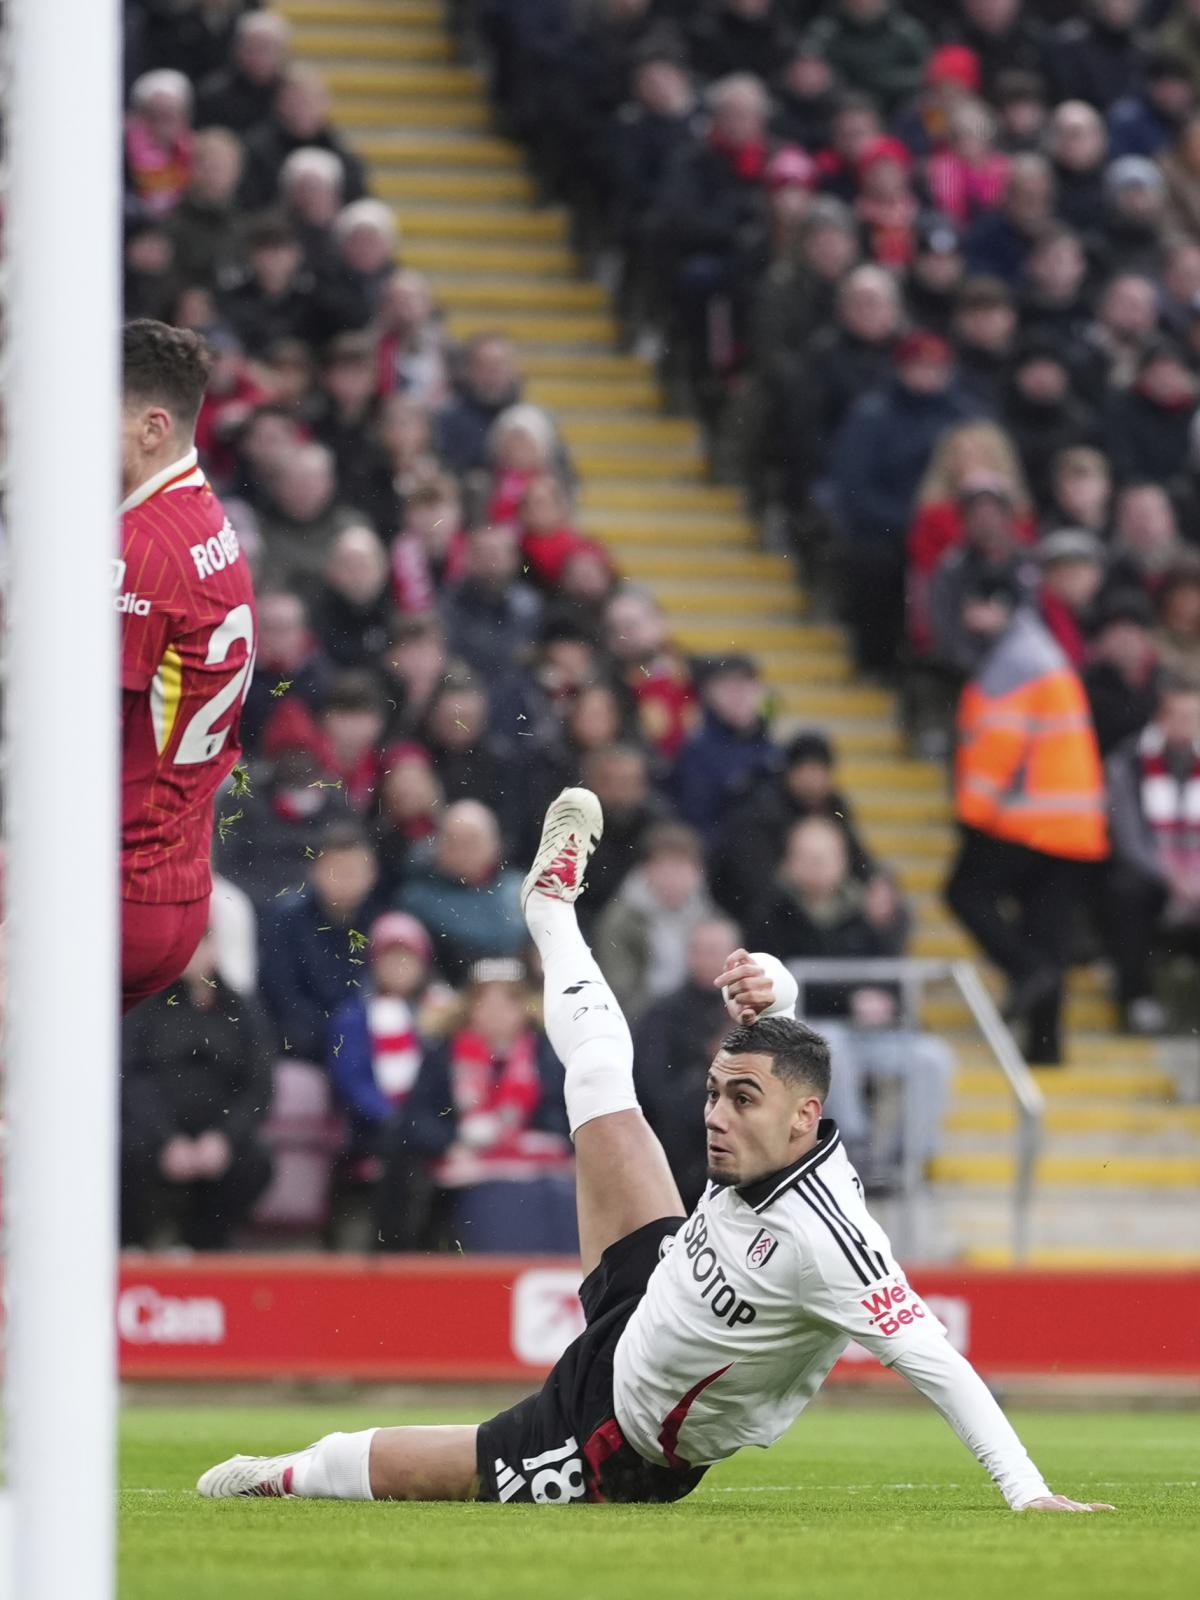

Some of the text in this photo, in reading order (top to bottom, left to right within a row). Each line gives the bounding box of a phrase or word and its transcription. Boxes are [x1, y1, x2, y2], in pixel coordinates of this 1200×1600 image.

[173, 603, 257, 765] 2
[118, 1285, 224, 1344] Can
[684, 1213, 756, 1328] SBOTOP
[522, 1436, 586, 1504] 18
